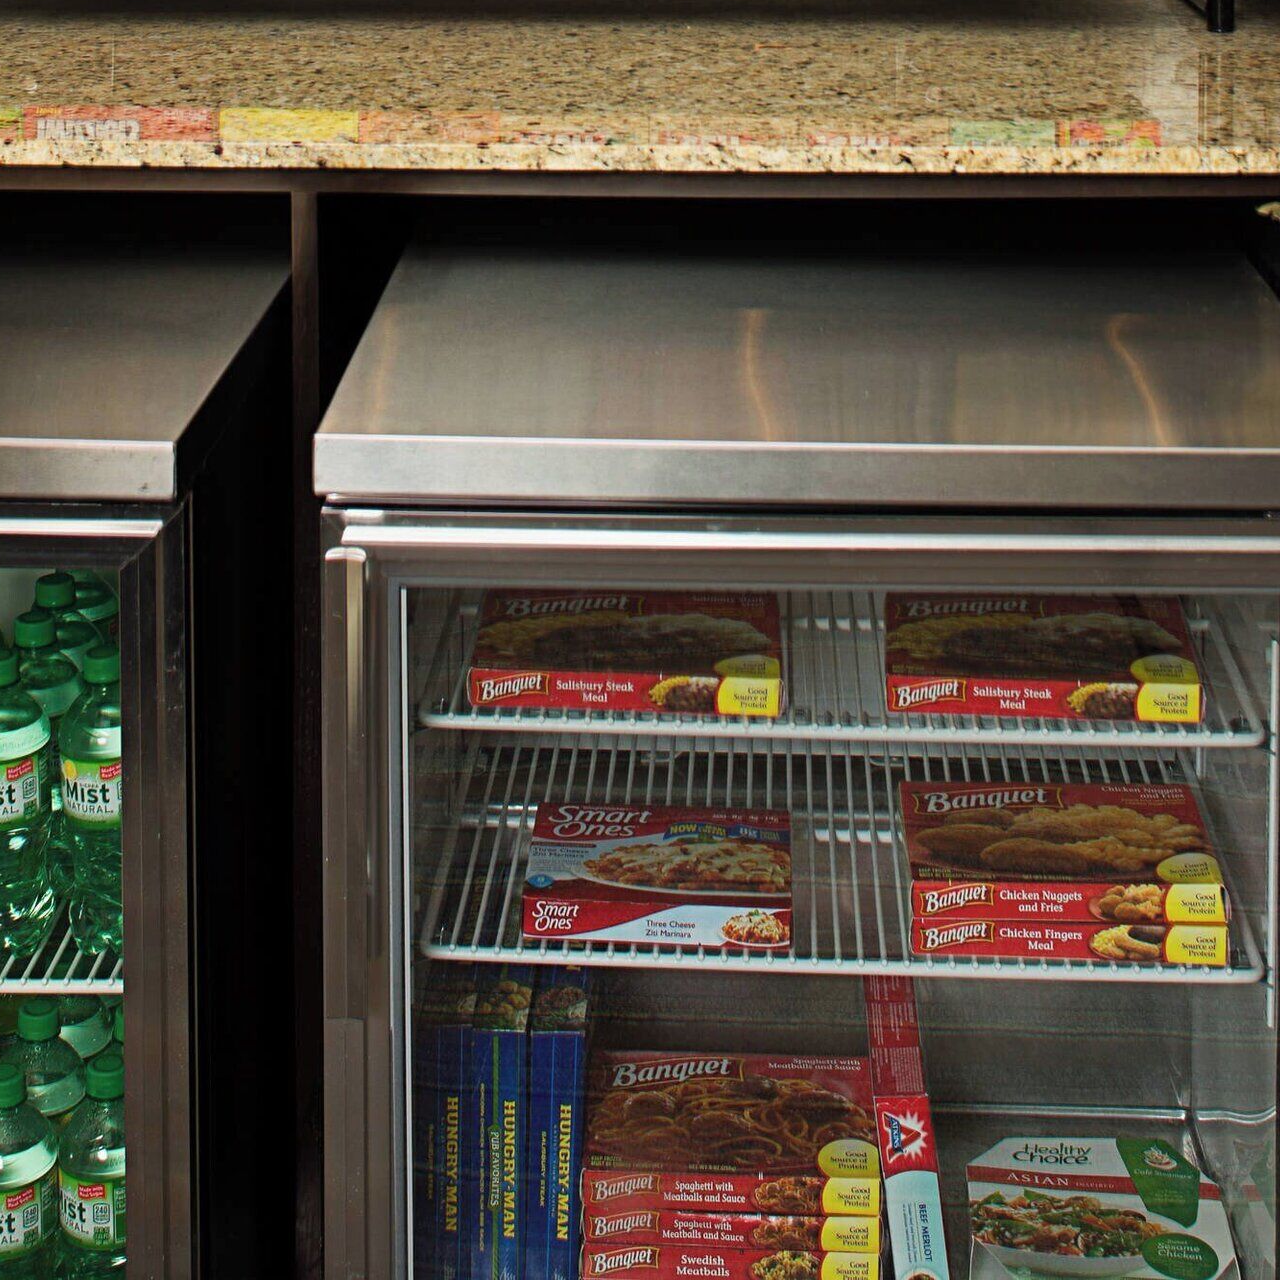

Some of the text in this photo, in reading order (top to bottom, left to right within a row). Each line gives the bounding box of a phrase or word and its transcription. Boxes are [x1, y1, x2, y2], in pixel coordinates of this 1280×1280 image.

[480, 673, 543, 702] Banquet
[555, 679, 635, 694] Salisbury Steak
[746, 686, 768, 696] Good
[896, 680, 960, 707] Banquet
[972, 686, 1053, 701] Salisbury Steak
[581, 692, 608, 703] Meal
[732, 694, 759, 702] Source
[739, 700, 768, 709] Protein
[999, 699, 1026, 710] Meal
[1152, 700, 1180, 708] Source
[1167, 693, 1188, 702] Good
[1159, 707, 1189, 716] Protein
[66, 778, 111, 804] Mist
[924, 788, 1047, 814] Banquet
[549, 806, 653, 825] Smart
[553, 821, 637, 838] Ones
[925, 885, 988, 913] Banquet
[999, 890, 1083, 903] Chicken Nuggets
[532, 900, 580, 918] Smart
[1017, 903, 1064, 913] and Fries
[535, 915, 573, 932] Ones
[645, 920, 696, 930] Three Cheese
[645, 929, 692, 939] Ziti Marinara
[925, 923, 987, 948] Banquet
[998, 928, 1083, 941] Chicken Fingers
[1027, 940, 1055, 951] Meal
[612, 1058, 732, 1087] Banquet
[891, 1119, 902, 1149] ATKINS
[1022, 1142, 1092, 1157] Healthy
[1012, 1150, 1089, 1165] Choice
[489, 1130, 501, 1207] PUB FAVORITES
[502, 1100, 516, 1239] HUNGRY-MAN
[556, 1104, 572, 1241] HUNGRY-MAN
[1006, 1172, 1069, 1187] ASIAN
[595, 1175, 654, 1201] Banquet
[674, 1181, 714, 1194] Spaghetti
[663, 1192, 746, 1204] Meatballs Sauce
[95, 1205, 108, 1215] 240
[594, 1213, 653, 1236] Banquet
[719, 1232, 745, 1242] Sauce
[918, 1203, 933, 1262] BEEF MERLOT
[1156, 1242, 1200, 1253] Sesame
[680, 1254, 725, 1266] Swedish
[676, 1266, 730, 1277] Meatballs
